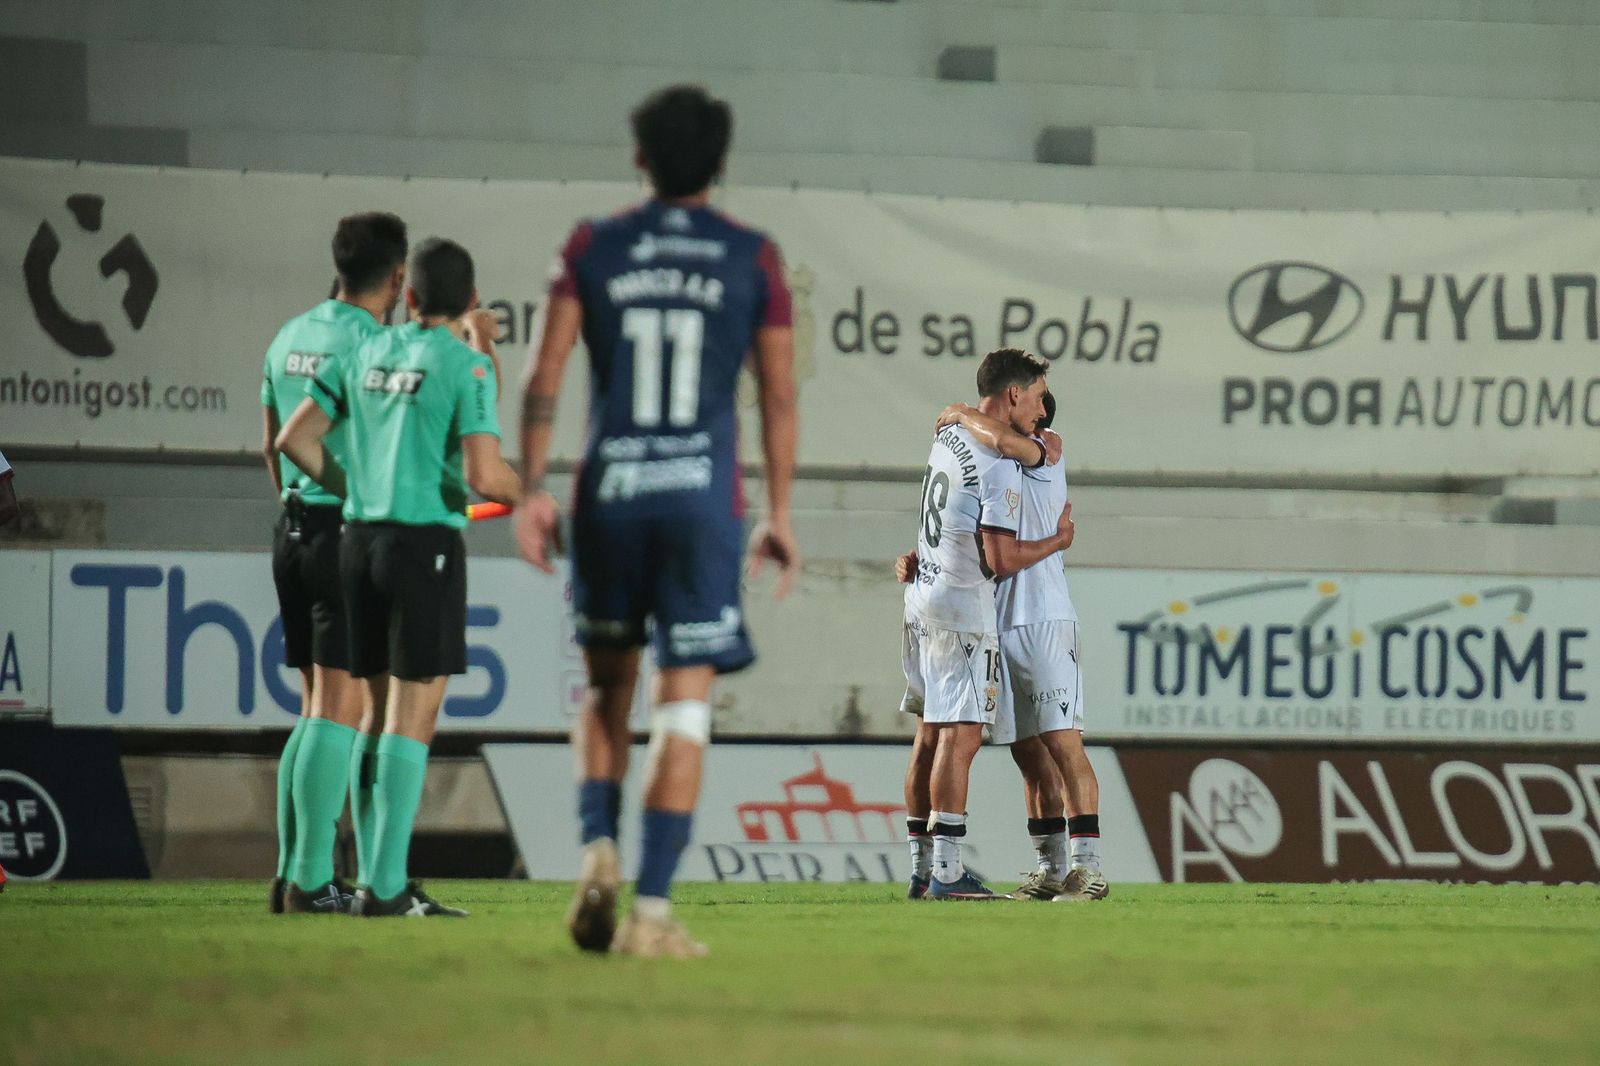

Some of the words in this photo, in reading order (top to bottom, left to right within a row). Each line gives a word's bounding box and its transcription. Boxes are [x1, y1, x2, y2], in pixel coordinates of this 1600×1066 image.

[831, 286, 901, 355] de
[920, 311, 976, 357] sa
[998, 295, 1162, 363] Pobla
[285, 351, 331, 380] BK
[622, 307, 704, 428] 11
[934, 429, 979, 488] ARROMAN
[1116, 622, 1336, 700] TOMEU
[1379, 624, 1590, 702] COSME
